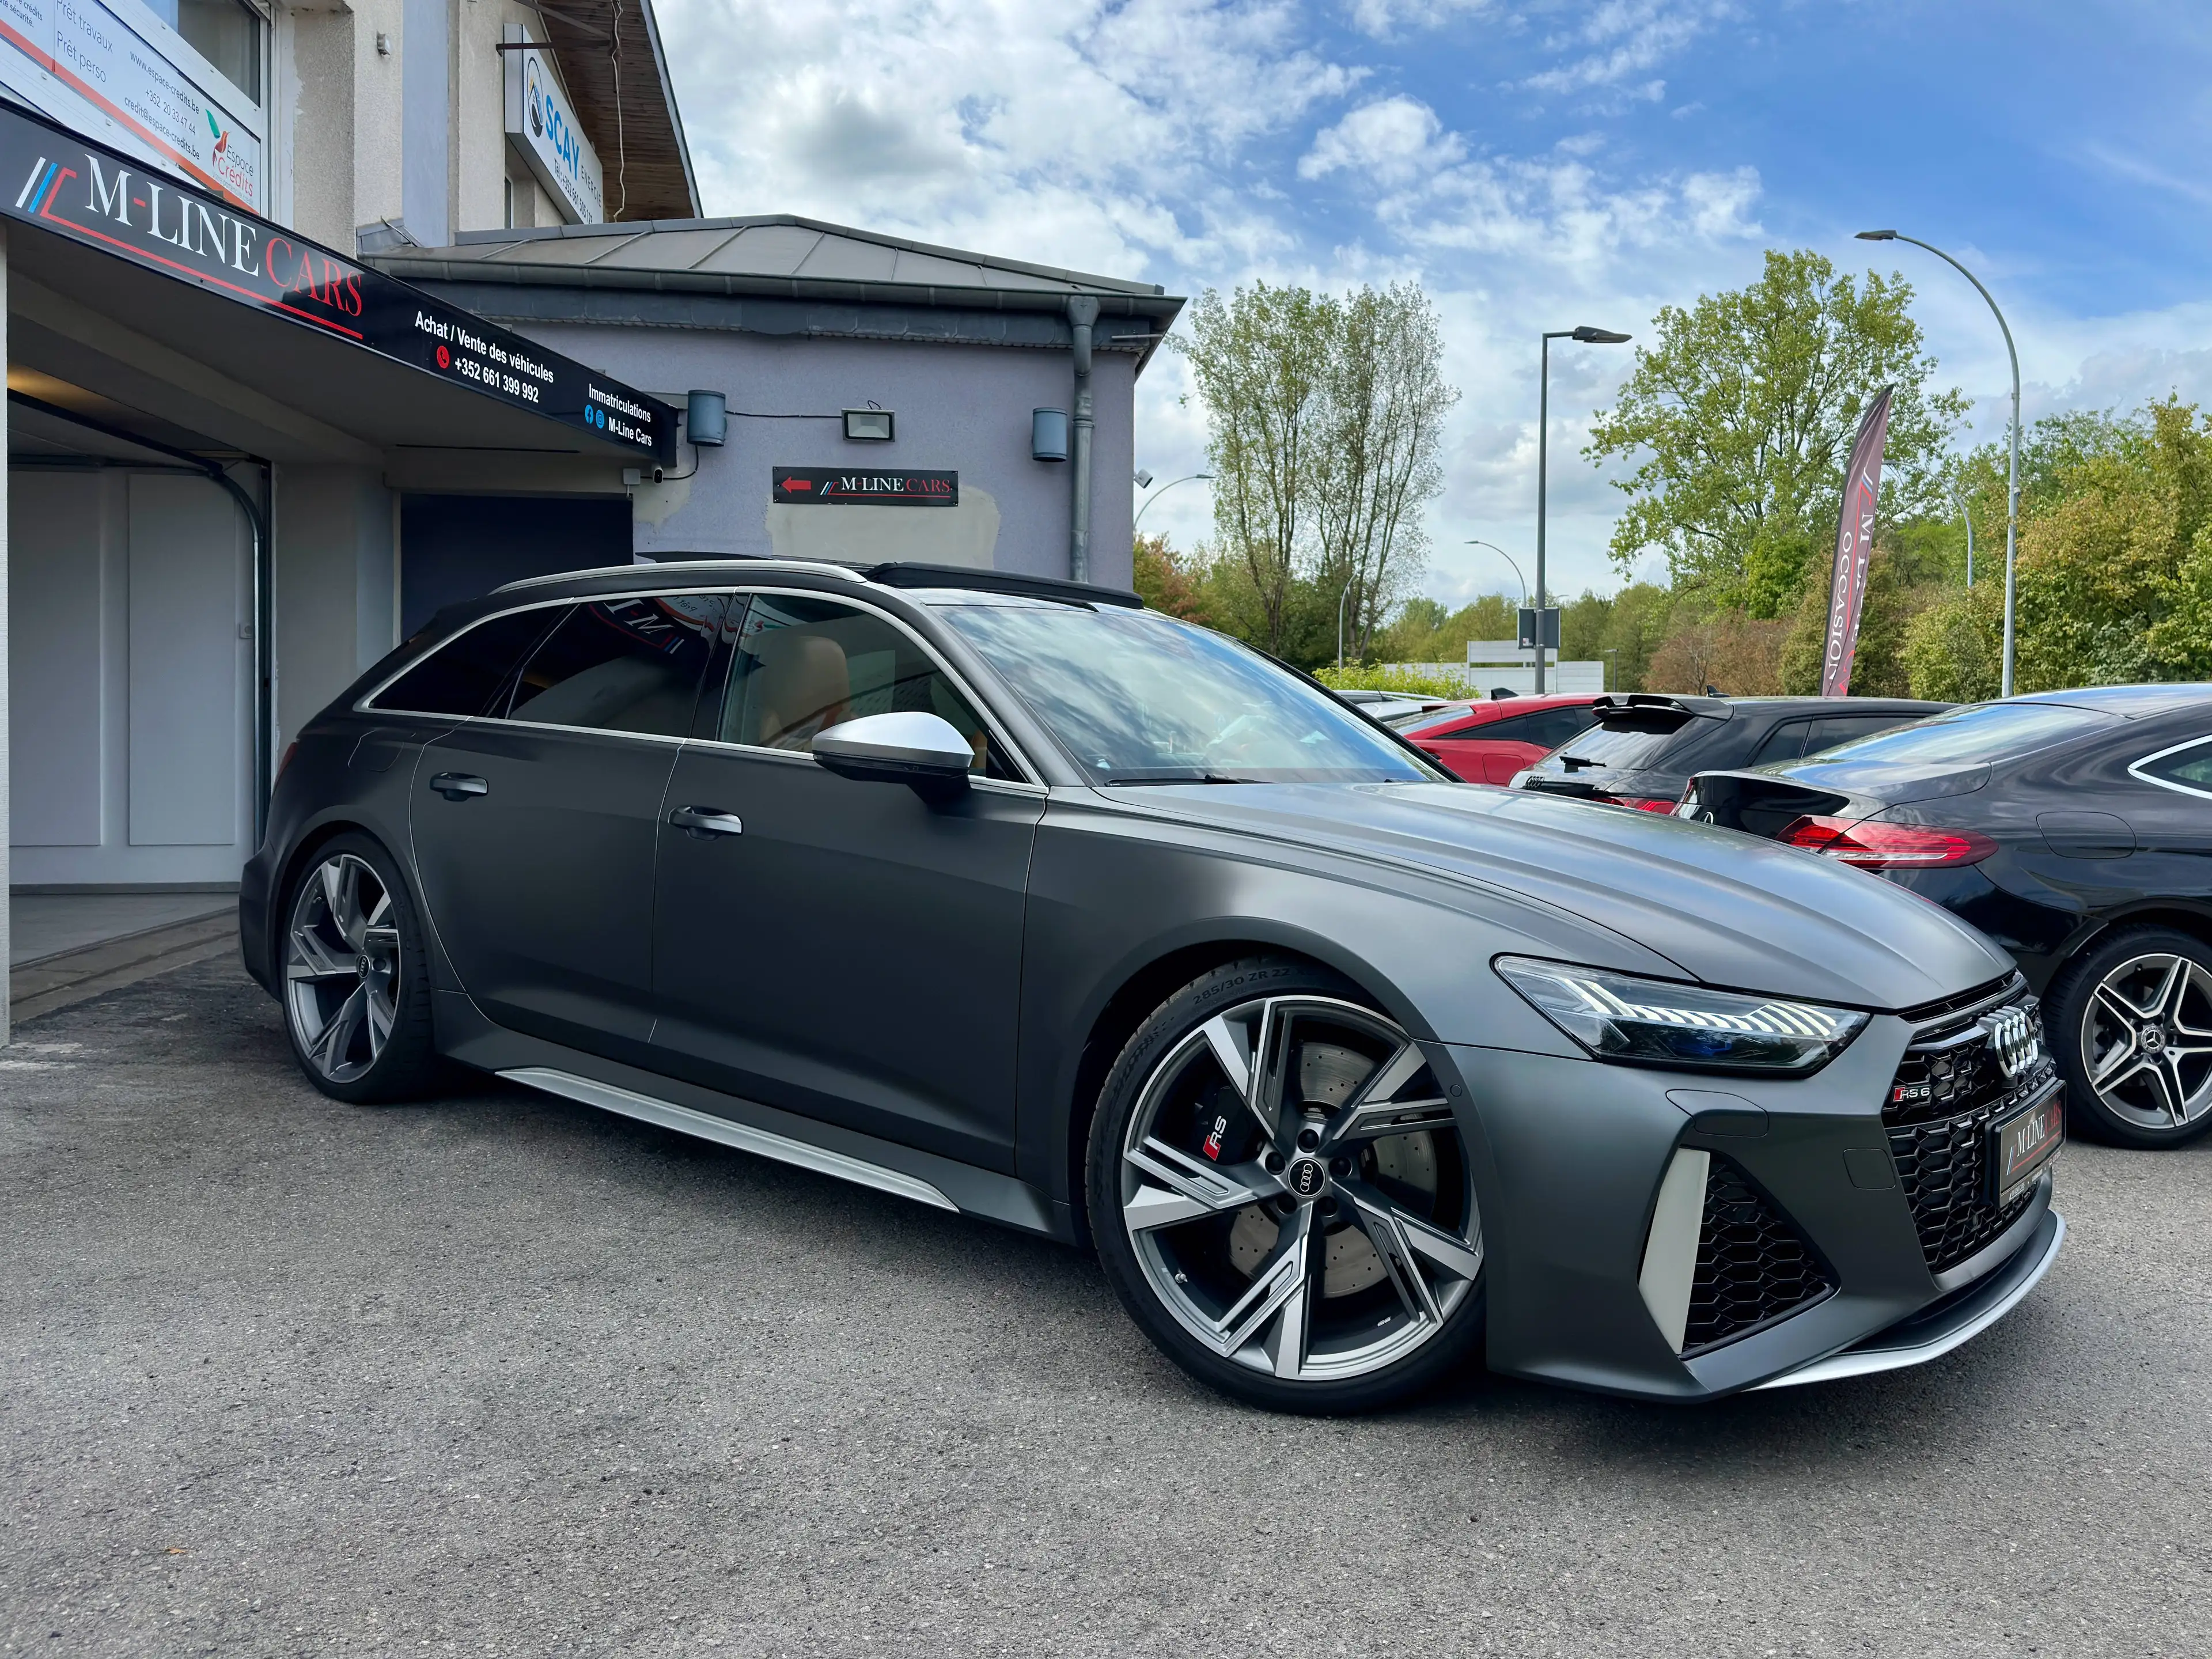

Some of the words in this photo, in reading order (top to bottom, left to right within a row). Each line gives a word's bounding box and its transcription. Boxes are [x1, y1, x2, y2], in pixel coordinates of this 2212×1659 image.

[10, 5, 34, 28] sécurité.
[24, 2, 43, 21] crédits
[79, 14, 113, 54] travaux
[57, 31, 77, 61] Prêt
[79, 54, 106, 82] perso
[130, 51, 199, 114] www.espace-credits.be
[124, 97, 199, 160] credit@espace-credits.be
[146, 89, 161, 108] +352
[164, 101, 171, 116] 20
[172, 109, 179, 122] 33
[180, 116, 187, 128] 47
[189, 123, 195, 136] 44
[546, 94, 579, 181] SCAY
[218, 157, 253, 196] Crédits
[227, 144, 253, 176] Espace
[266, 238, 362, 316] CARS
[415, 310, 448, 340] Achat
[457, 327, 487, 355] Vente
[489, 343, 507, 364] des
[509, 353, 554, 383] véhicules
[454, 357, 480, 380] +352
[483, 369, 500, 388] 661
[503, 374, 520, 395] 399
[522, 384, 539, 403] 992
[589, 383, 651, 422] Immatriculations
[608, 416, 634, 440] M-Line
[636, 427, 652, 446] Cars
[840, 476, 904, 491] M-LINE
[906, 478, 950, 493] CARS
[1192, 976, 1244, 1005] 285/30
[1248, 971, 1268, 981] ZR
[1272, 968, 1290, 976] 22
[1209, 1115, 1226, 1150] RS
